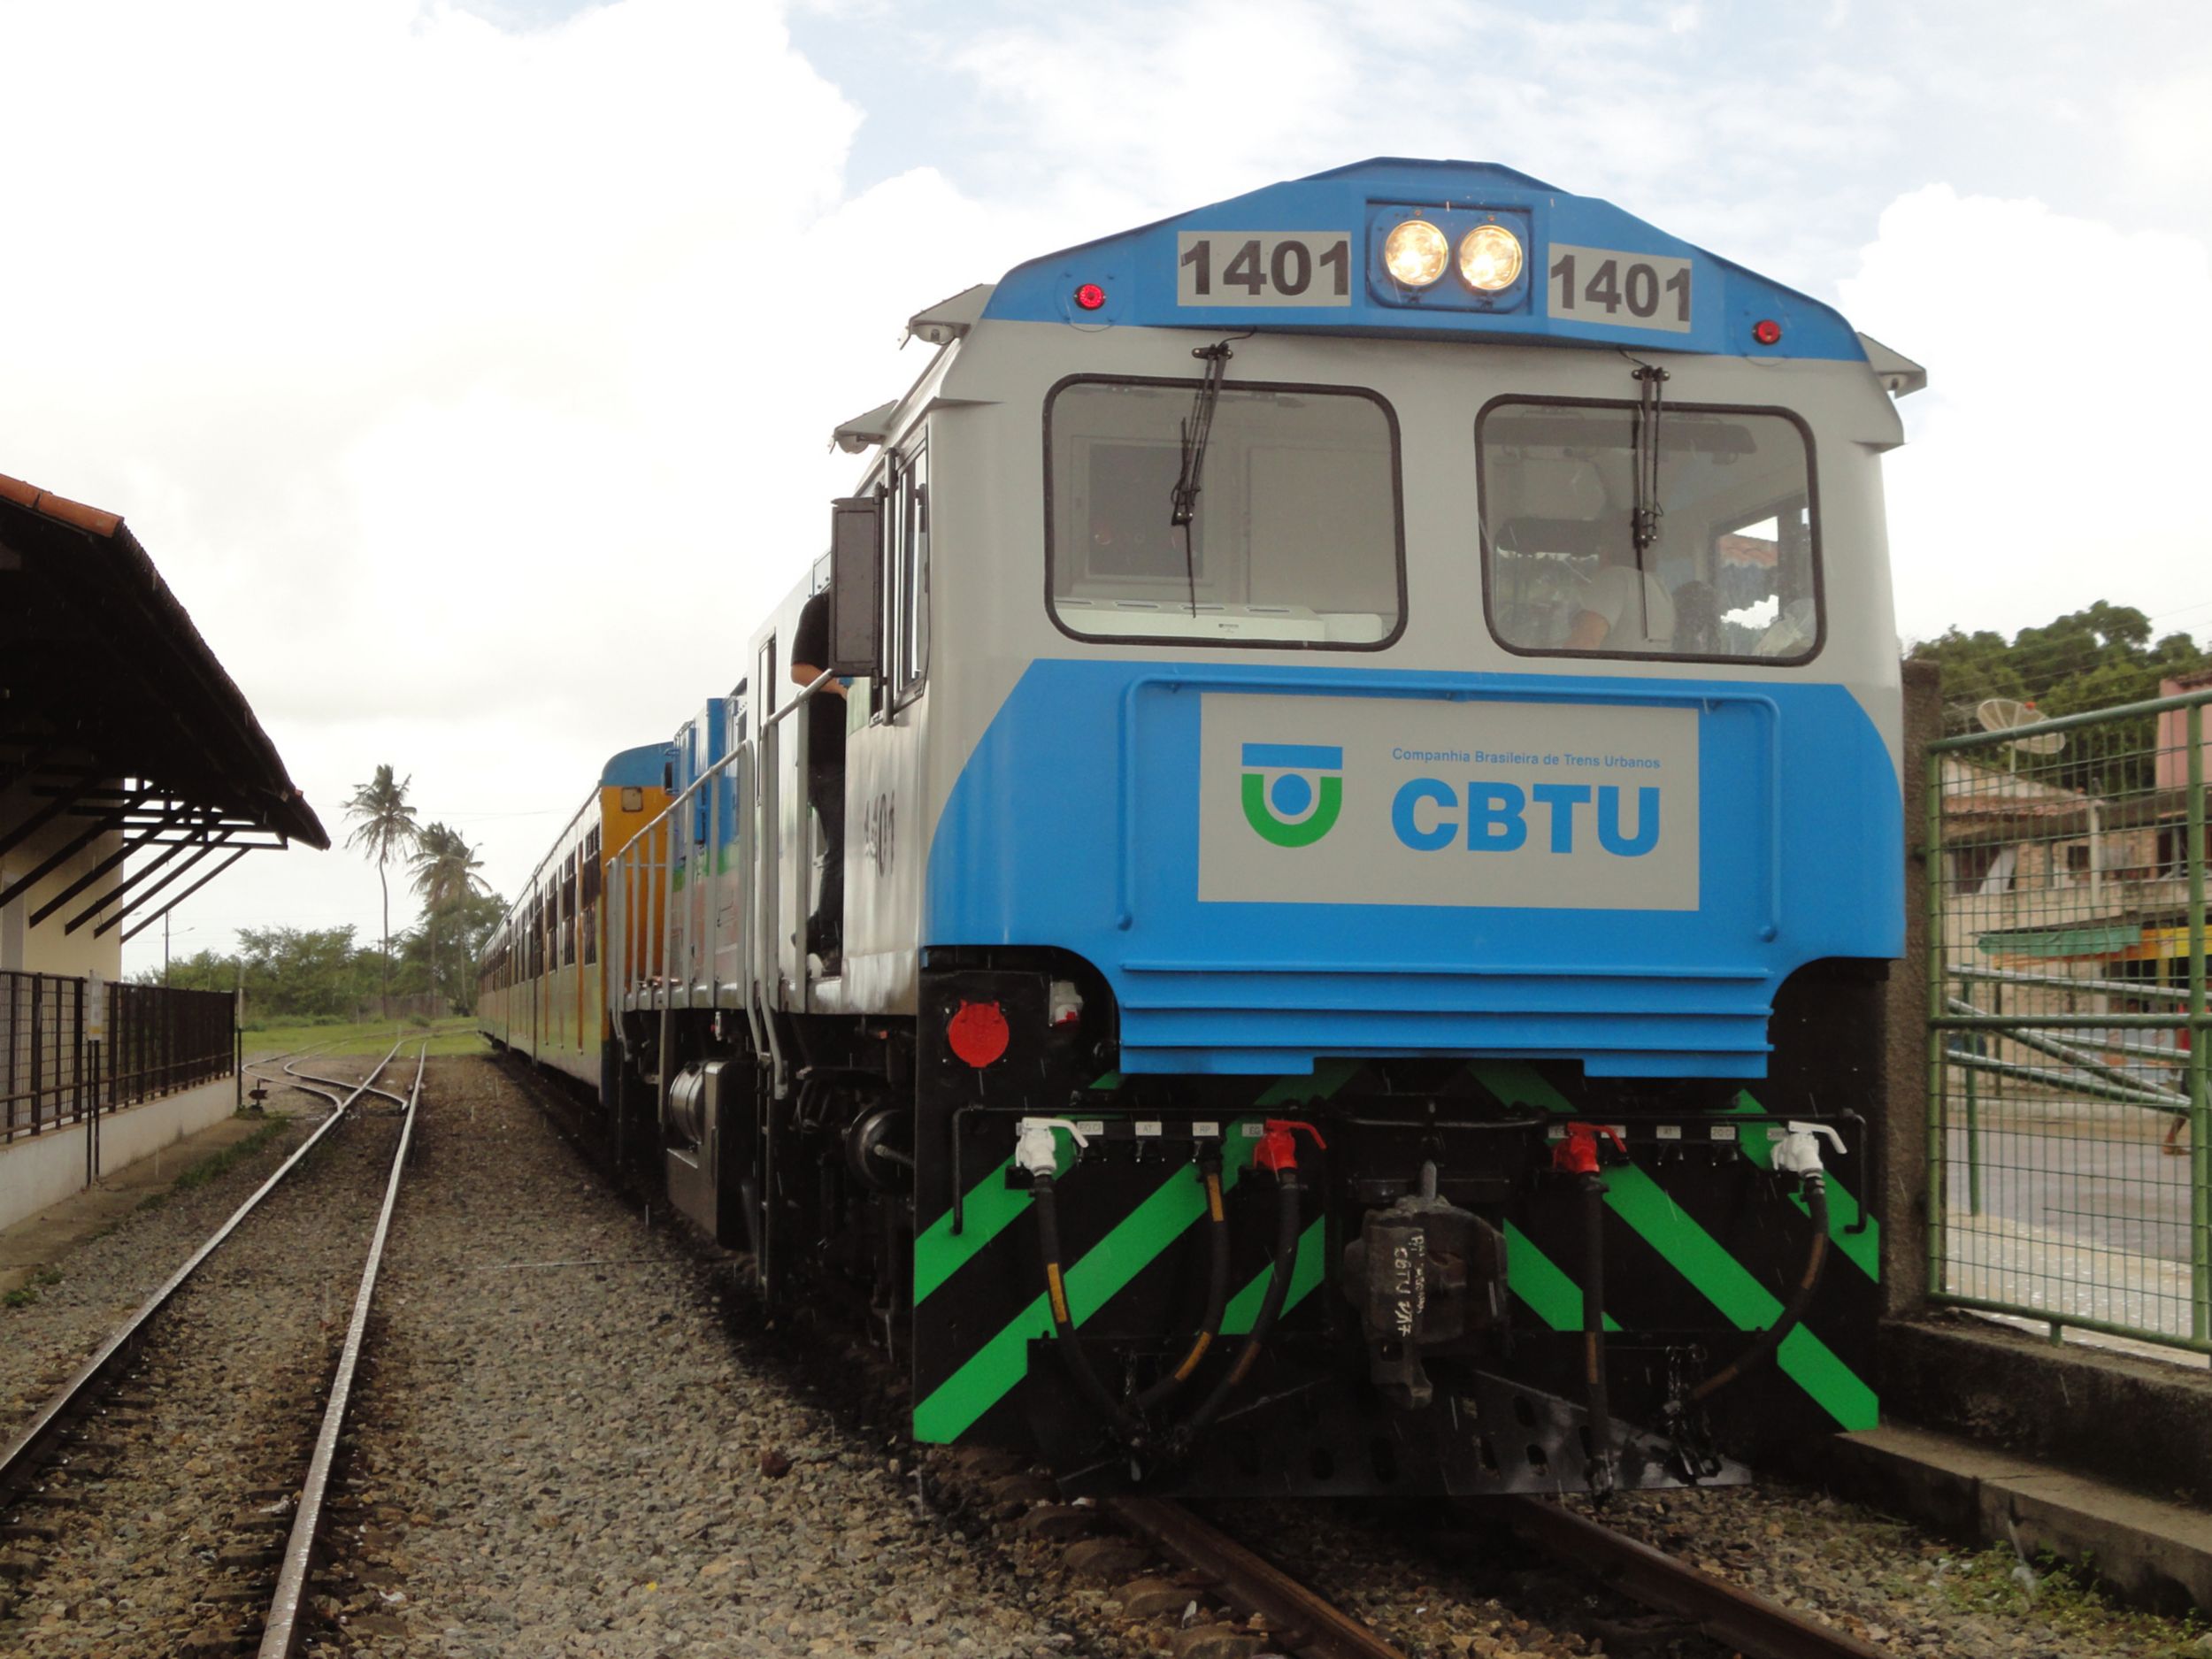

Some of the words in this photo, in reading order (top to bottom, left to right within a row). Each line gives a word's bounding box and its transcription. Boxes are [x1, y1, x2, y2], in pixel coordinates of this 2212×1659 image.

[1180, 239, 1350, 296] 1401
[1549, 253, 1691, 322] 1401
[1392, 748, 1471, 764] Companhia
[1474, 750, 1539, 765] Brasileira
[1543, 753, 1559, 765] de
[1563, 753, 1601, 767] Trens
[1604, 756, 1661, 769] Urbanos
[1391, 777, 1661, 857] CBTU
